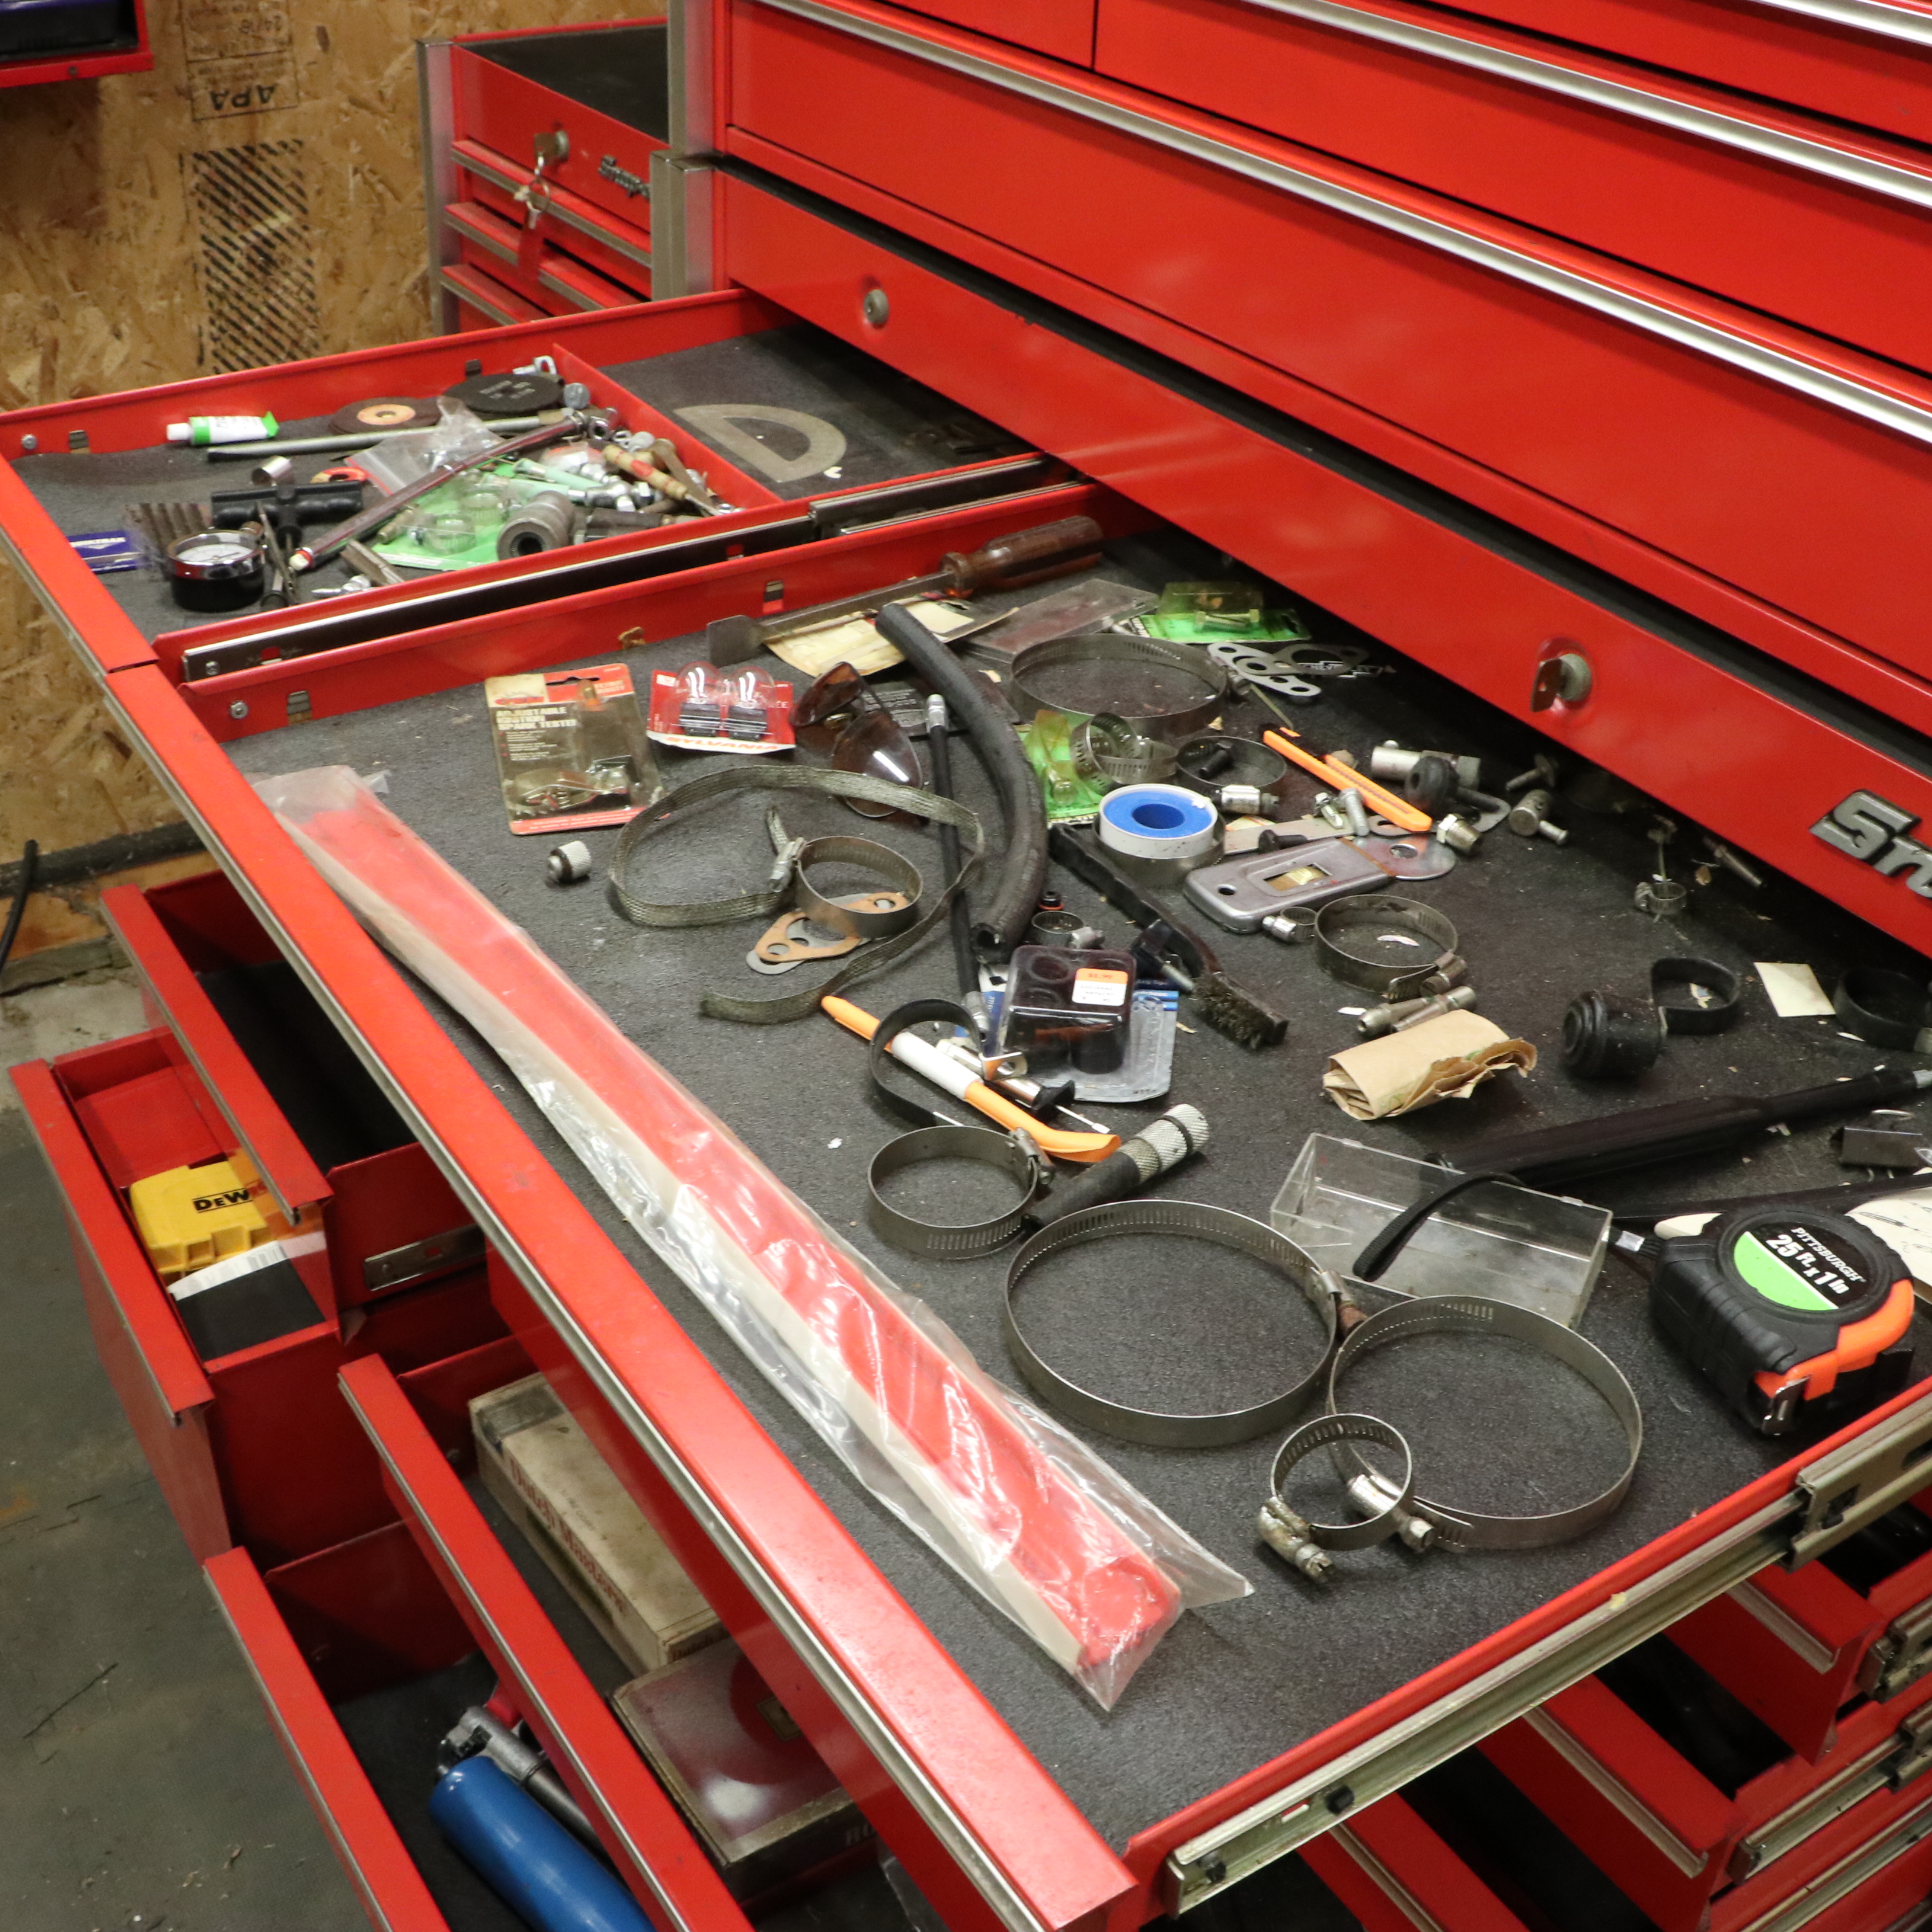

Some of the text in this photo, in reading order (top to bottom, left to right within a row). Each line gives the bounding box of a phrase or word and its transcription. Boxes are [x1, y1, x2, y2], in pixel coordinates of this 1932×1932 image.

[209, 84, 276, 111] APA
[495, 706, 567, 719] ADJUSTABLE
[666, 736, 779, 750] SYLVANIA
[193, 1189, 250, 1211] DEW
[1765, 1234, 1804, 1257] 25
[1814, 1271, 1838, 1285] 1
[508, 1457, 556, 1528] Dutch
[557, 1517, 627, 1616] Masters
